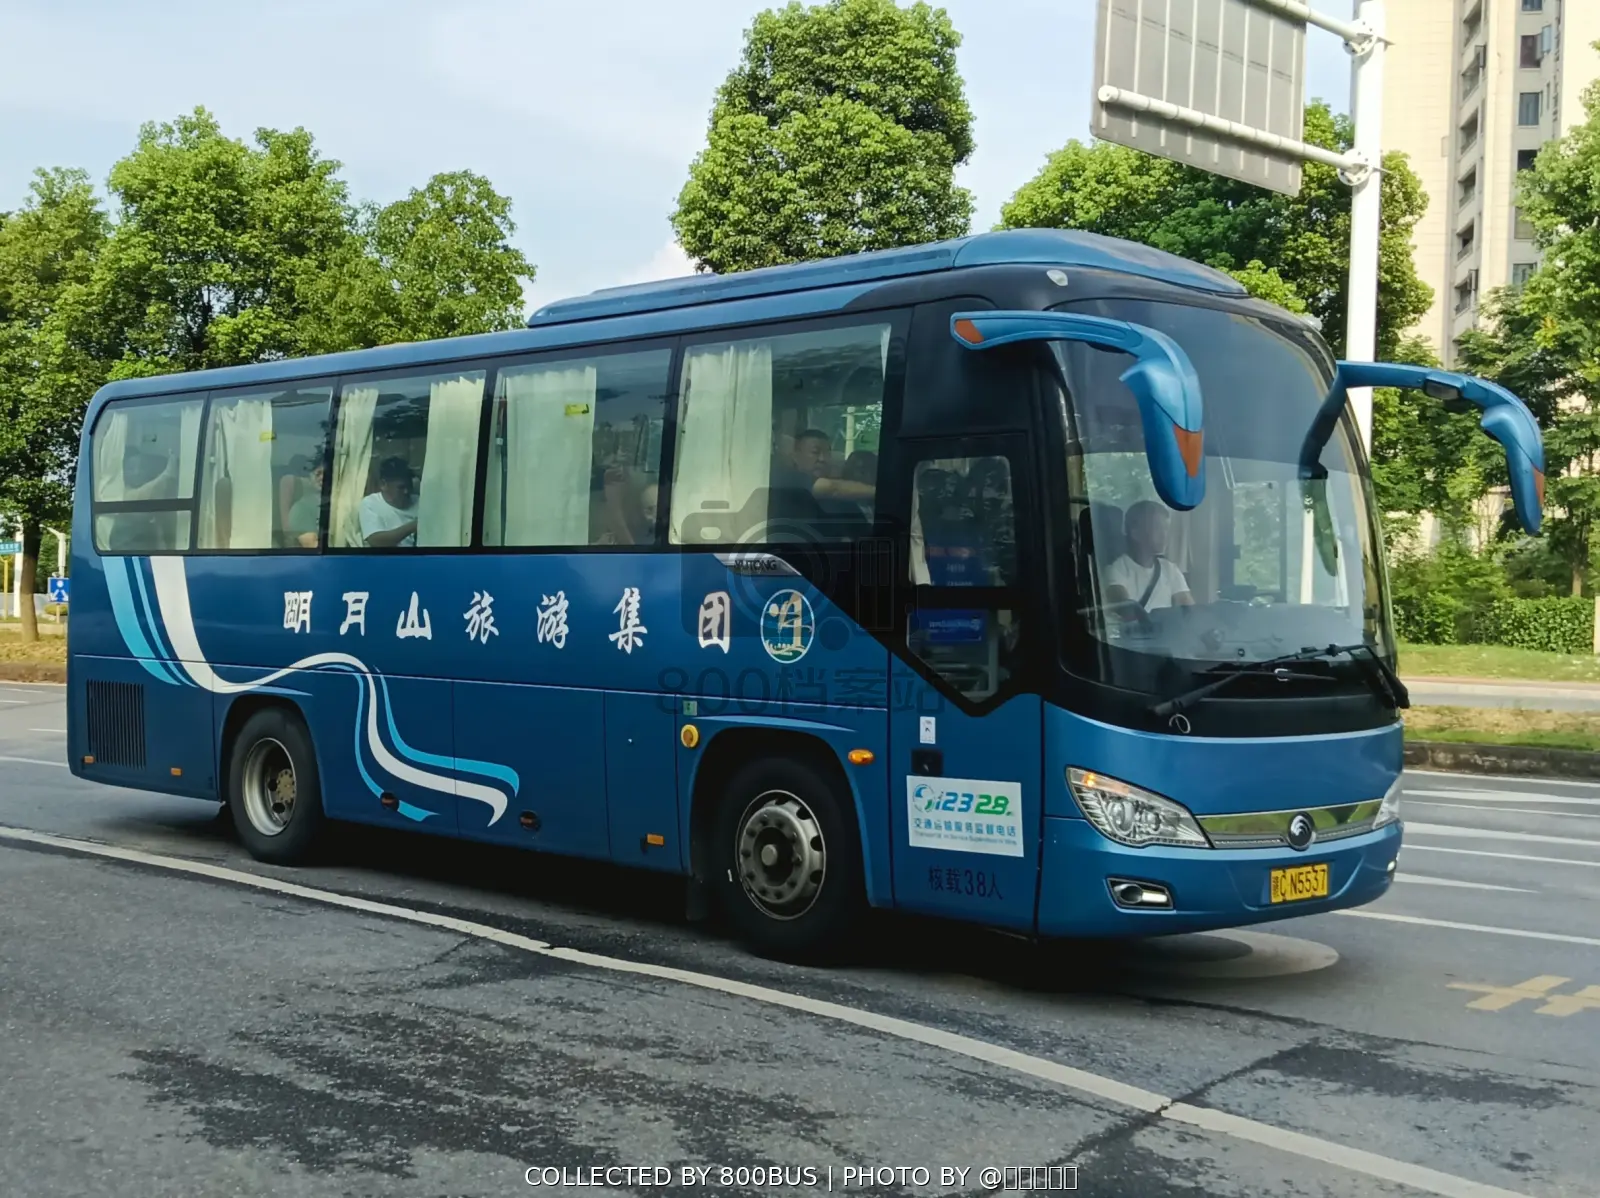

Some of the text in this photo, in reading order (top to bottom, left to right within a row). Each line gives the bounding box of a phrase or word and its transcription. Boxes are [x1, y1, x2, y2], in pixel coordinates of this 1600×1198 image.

[734, 560, 777, 571] YUTONG
[928, 865, 1004, 900] 核载38人
